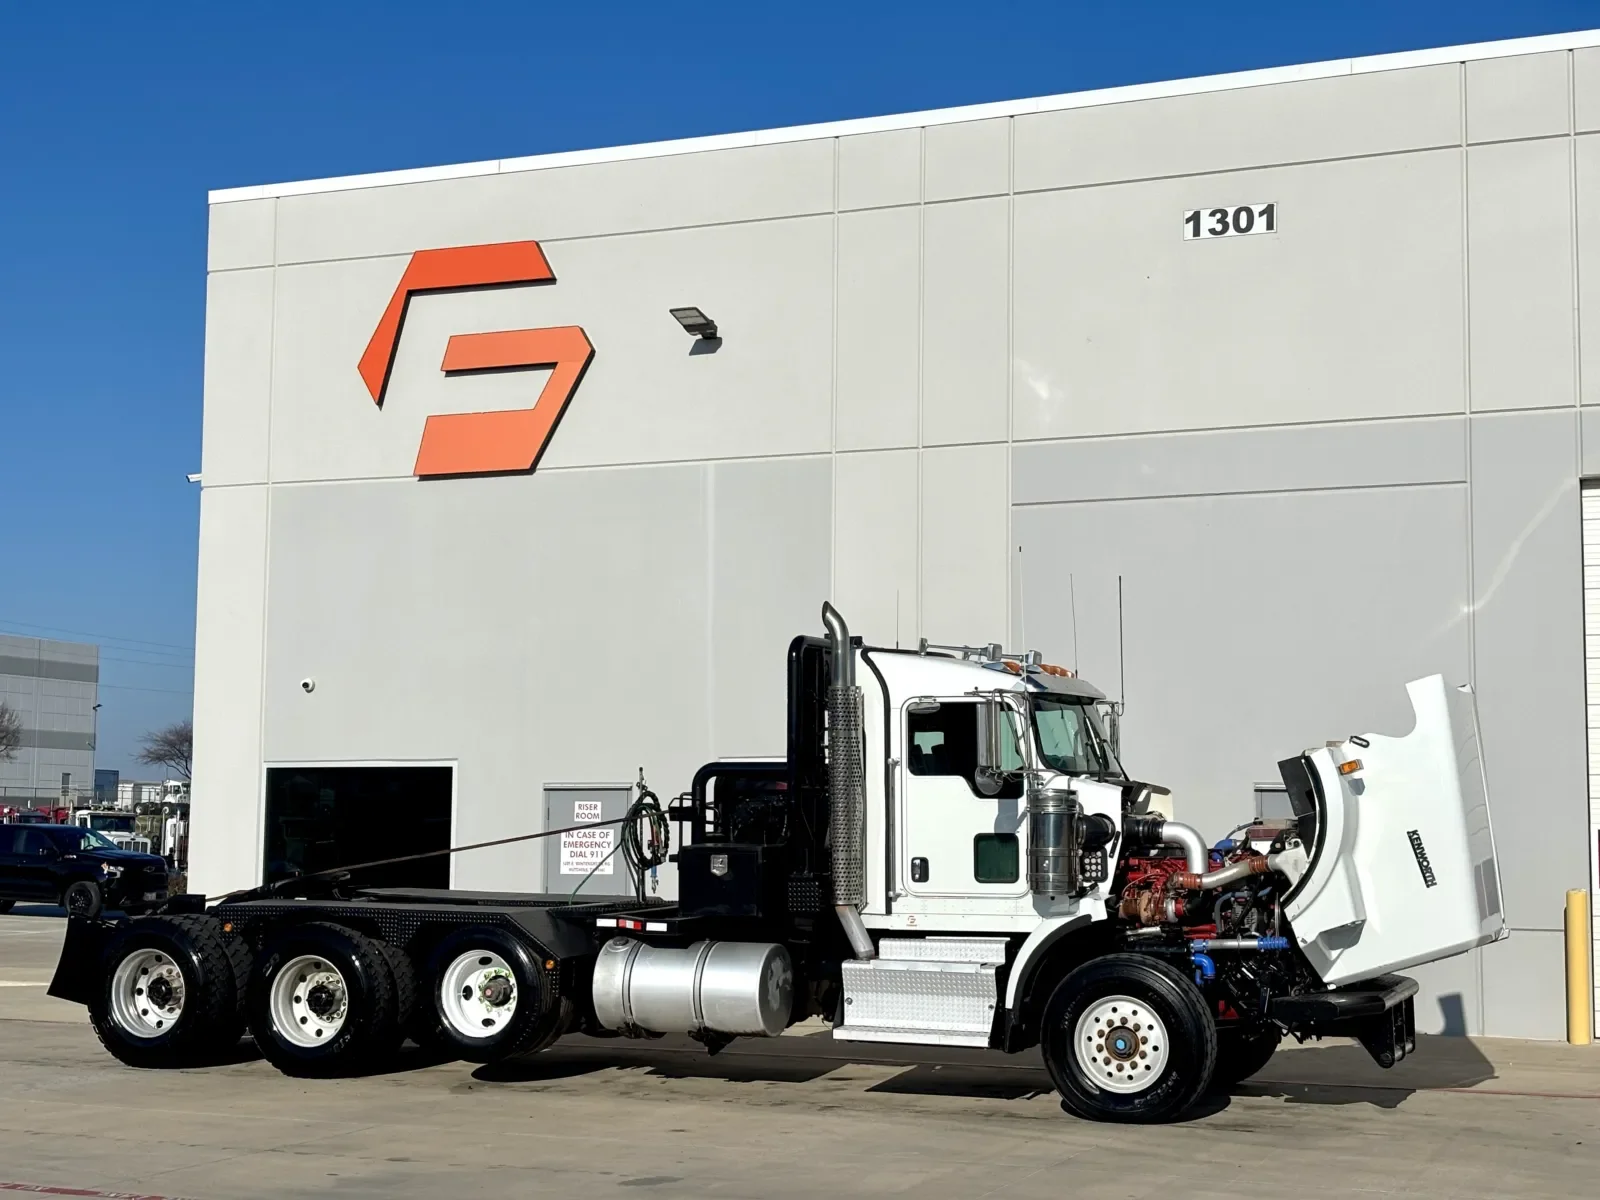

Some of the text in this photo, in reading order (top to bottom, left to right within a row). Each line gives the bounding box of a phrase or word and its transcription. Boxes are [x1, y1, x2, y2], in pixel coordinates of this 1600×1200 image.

[1185, 203, 1275, 238] 1301
[577, 803, 598, 811] RISER
[575, 812, 600, 820] ROOM
[565, 831, 610, 839] IN CASE OF
[563, 840, 612, 849] EMERGENCY
[569, 850, 604, 858] DIAL 911
[1406, 829, 1438, 889] KENWORTH
